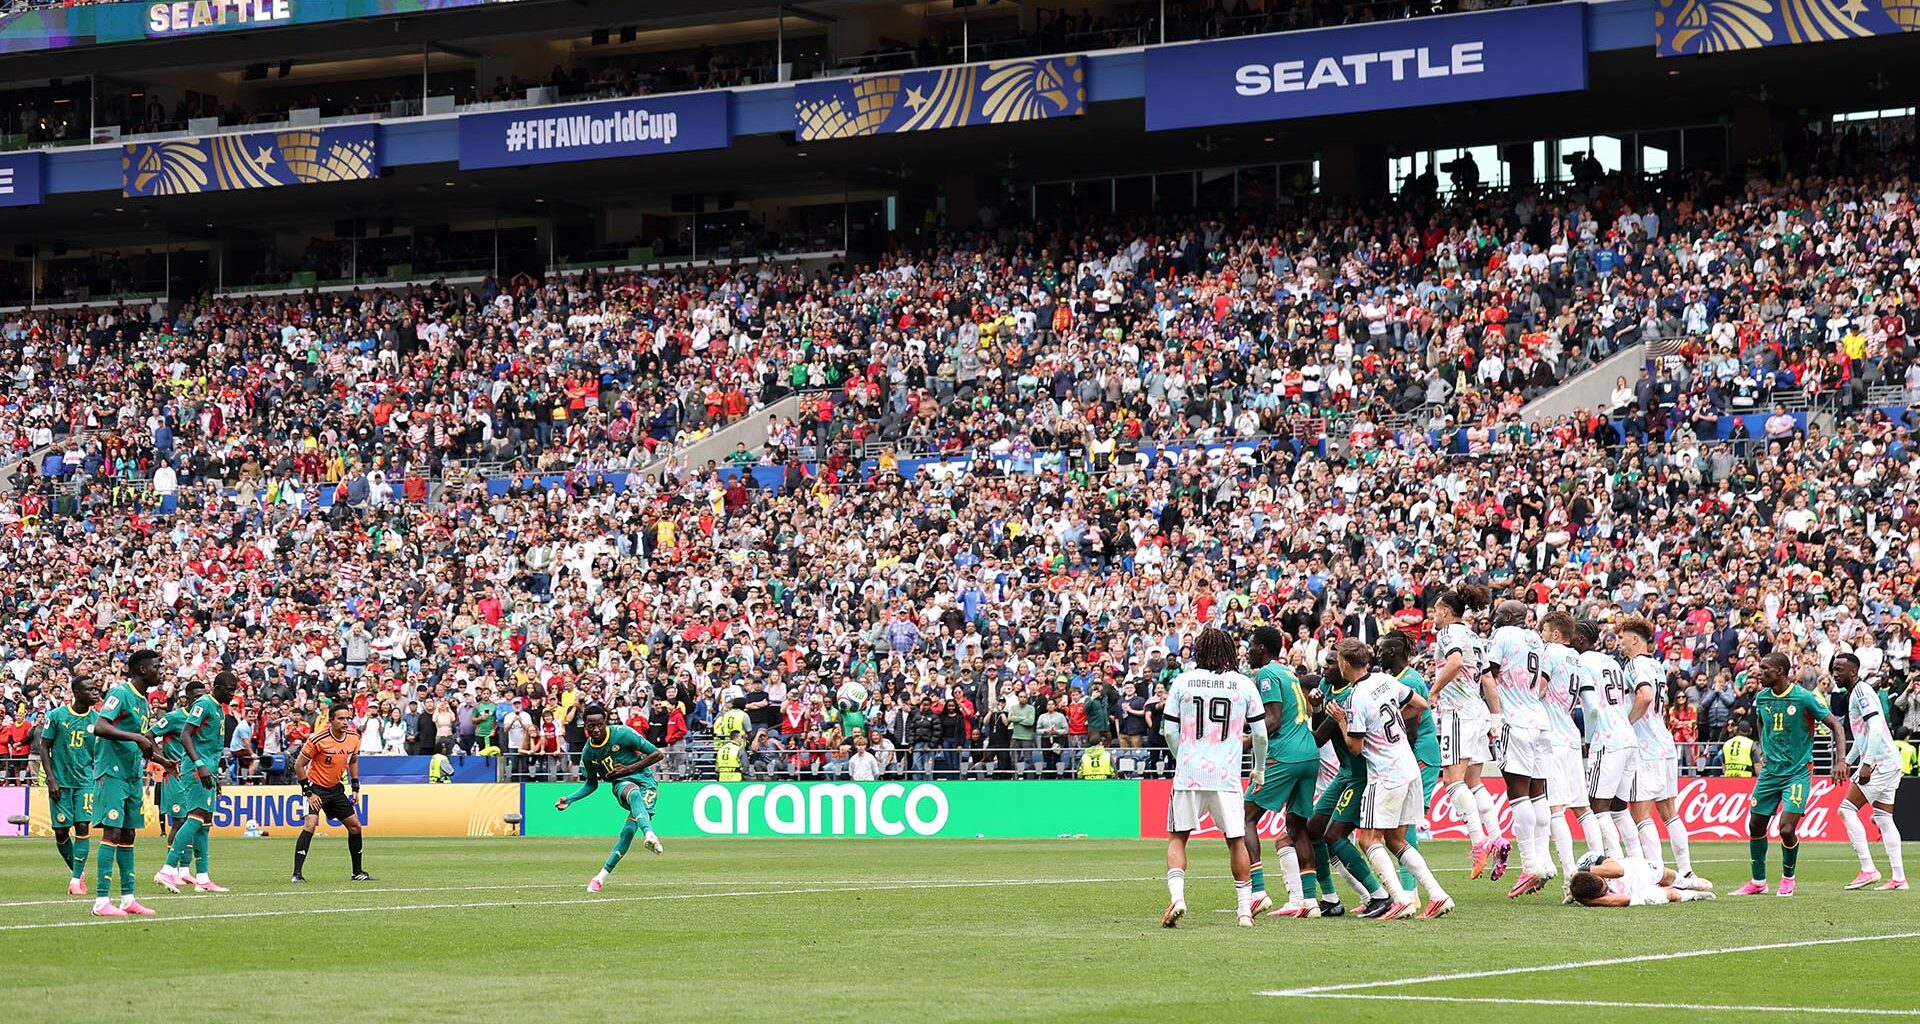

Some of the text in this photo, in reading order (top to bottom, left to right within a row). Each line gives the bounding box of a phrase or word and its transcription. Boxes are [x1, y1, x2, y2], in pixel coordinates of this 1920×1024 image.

[149, 0, 291, 32] SEATTLE
[1234, 41, 1484, 96] SEATTLE
[507, 109, 677, 152] #FIFAWorldCup
[1528, 652, 1539, 689] 9
[1602, 669, 1625, 705] 24
[1192, 696, 1232, 741] 19
[1772, 713, 1784, 731] 11
[69, 730, 84, 748] 15
[1442, 736, 1451, 751] 3
[692, 783, 949, 836] aramco
[1789, 783, 1803, 801] 11
